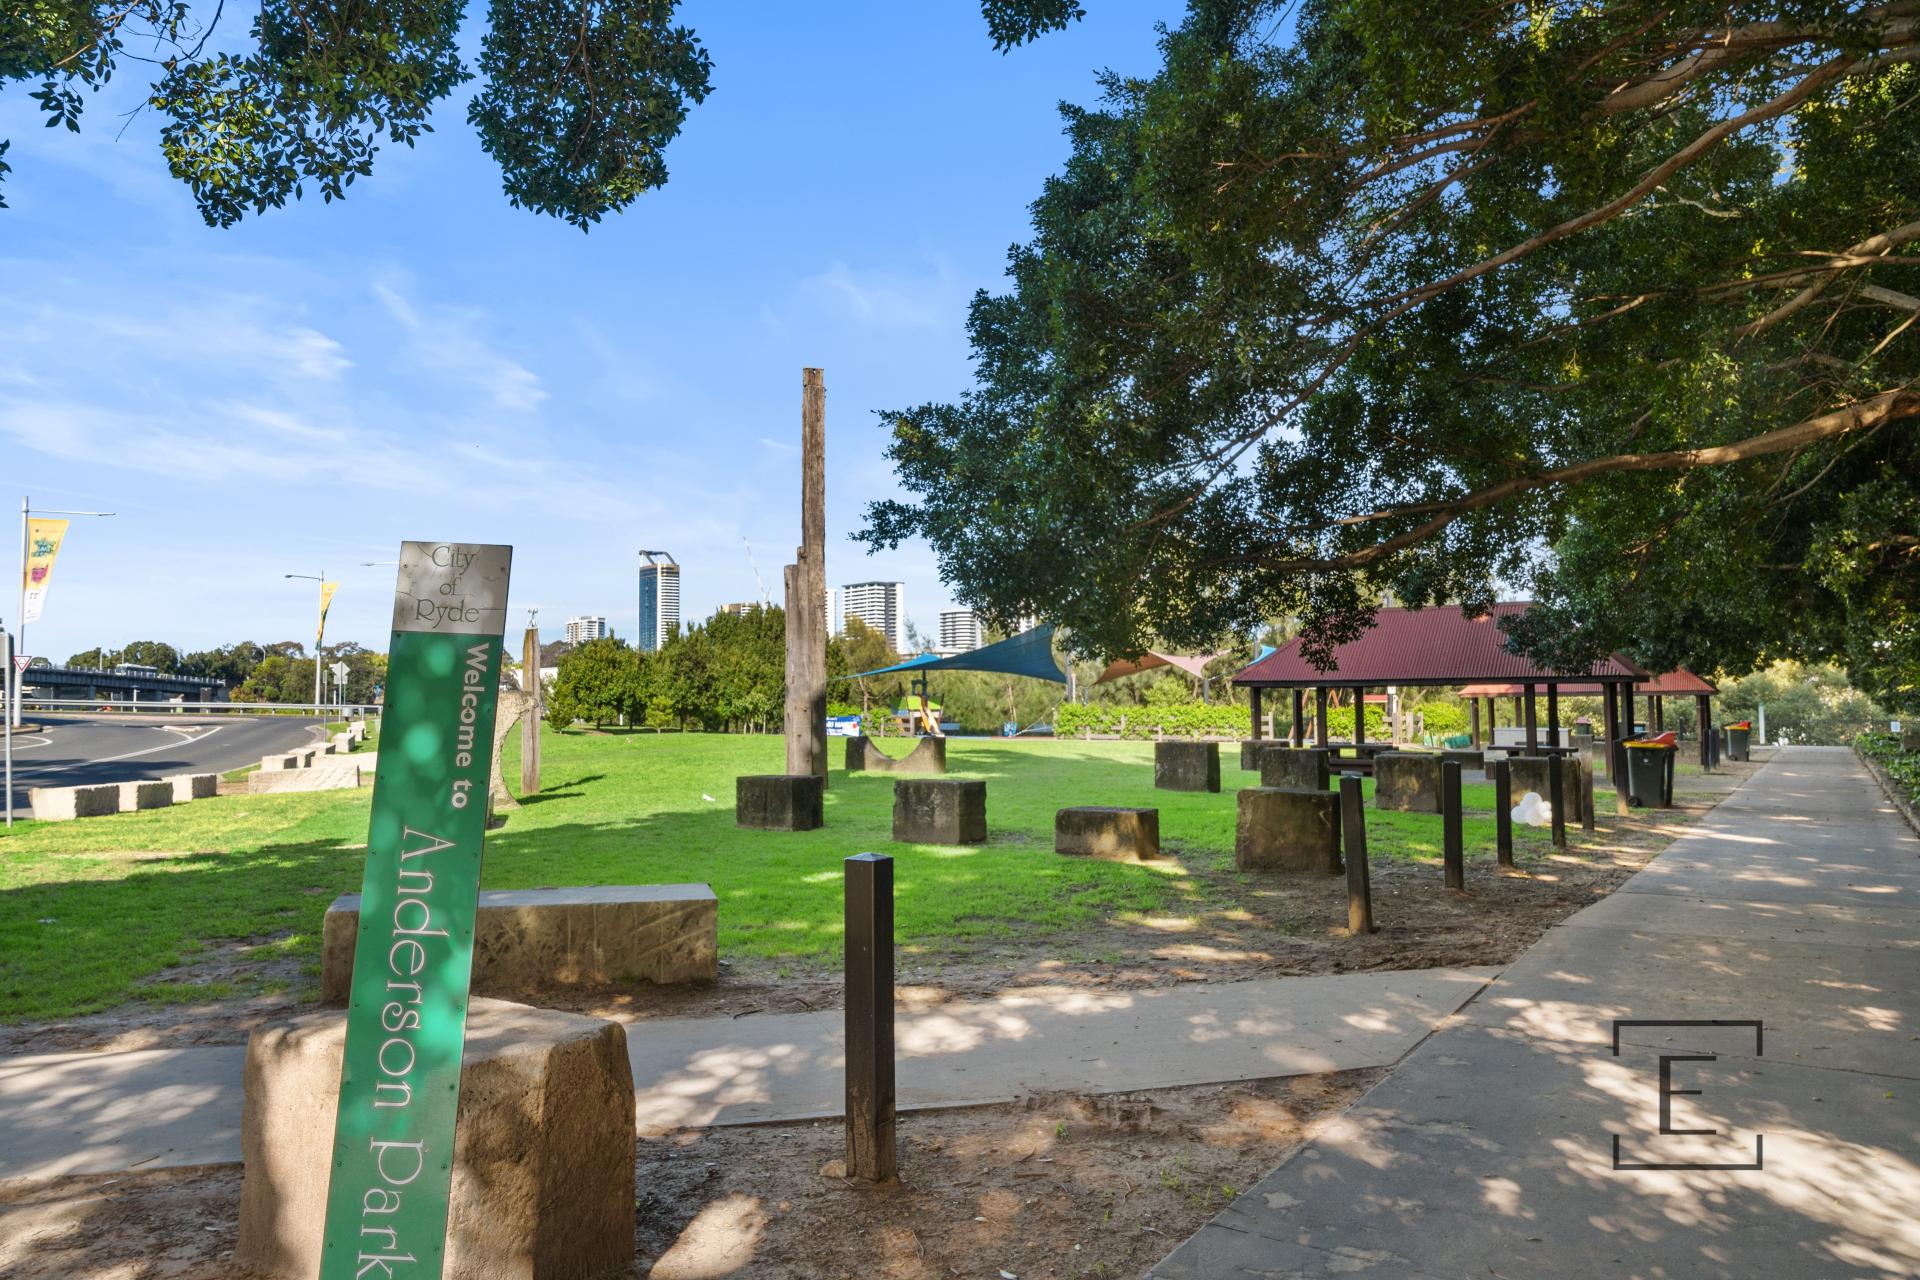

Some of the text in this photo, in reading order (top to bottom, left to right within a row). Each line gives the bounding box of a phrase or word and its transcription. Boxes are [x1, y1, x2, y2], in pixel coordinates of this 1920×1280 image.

[431, 545, 475, 575] City
[439, 576, 461, 596] of
[415, 599, 480, 629] Ryde
[451, 642, 490, 809] Welcome to
[356, 825, 456, 1280] Anderson Park
